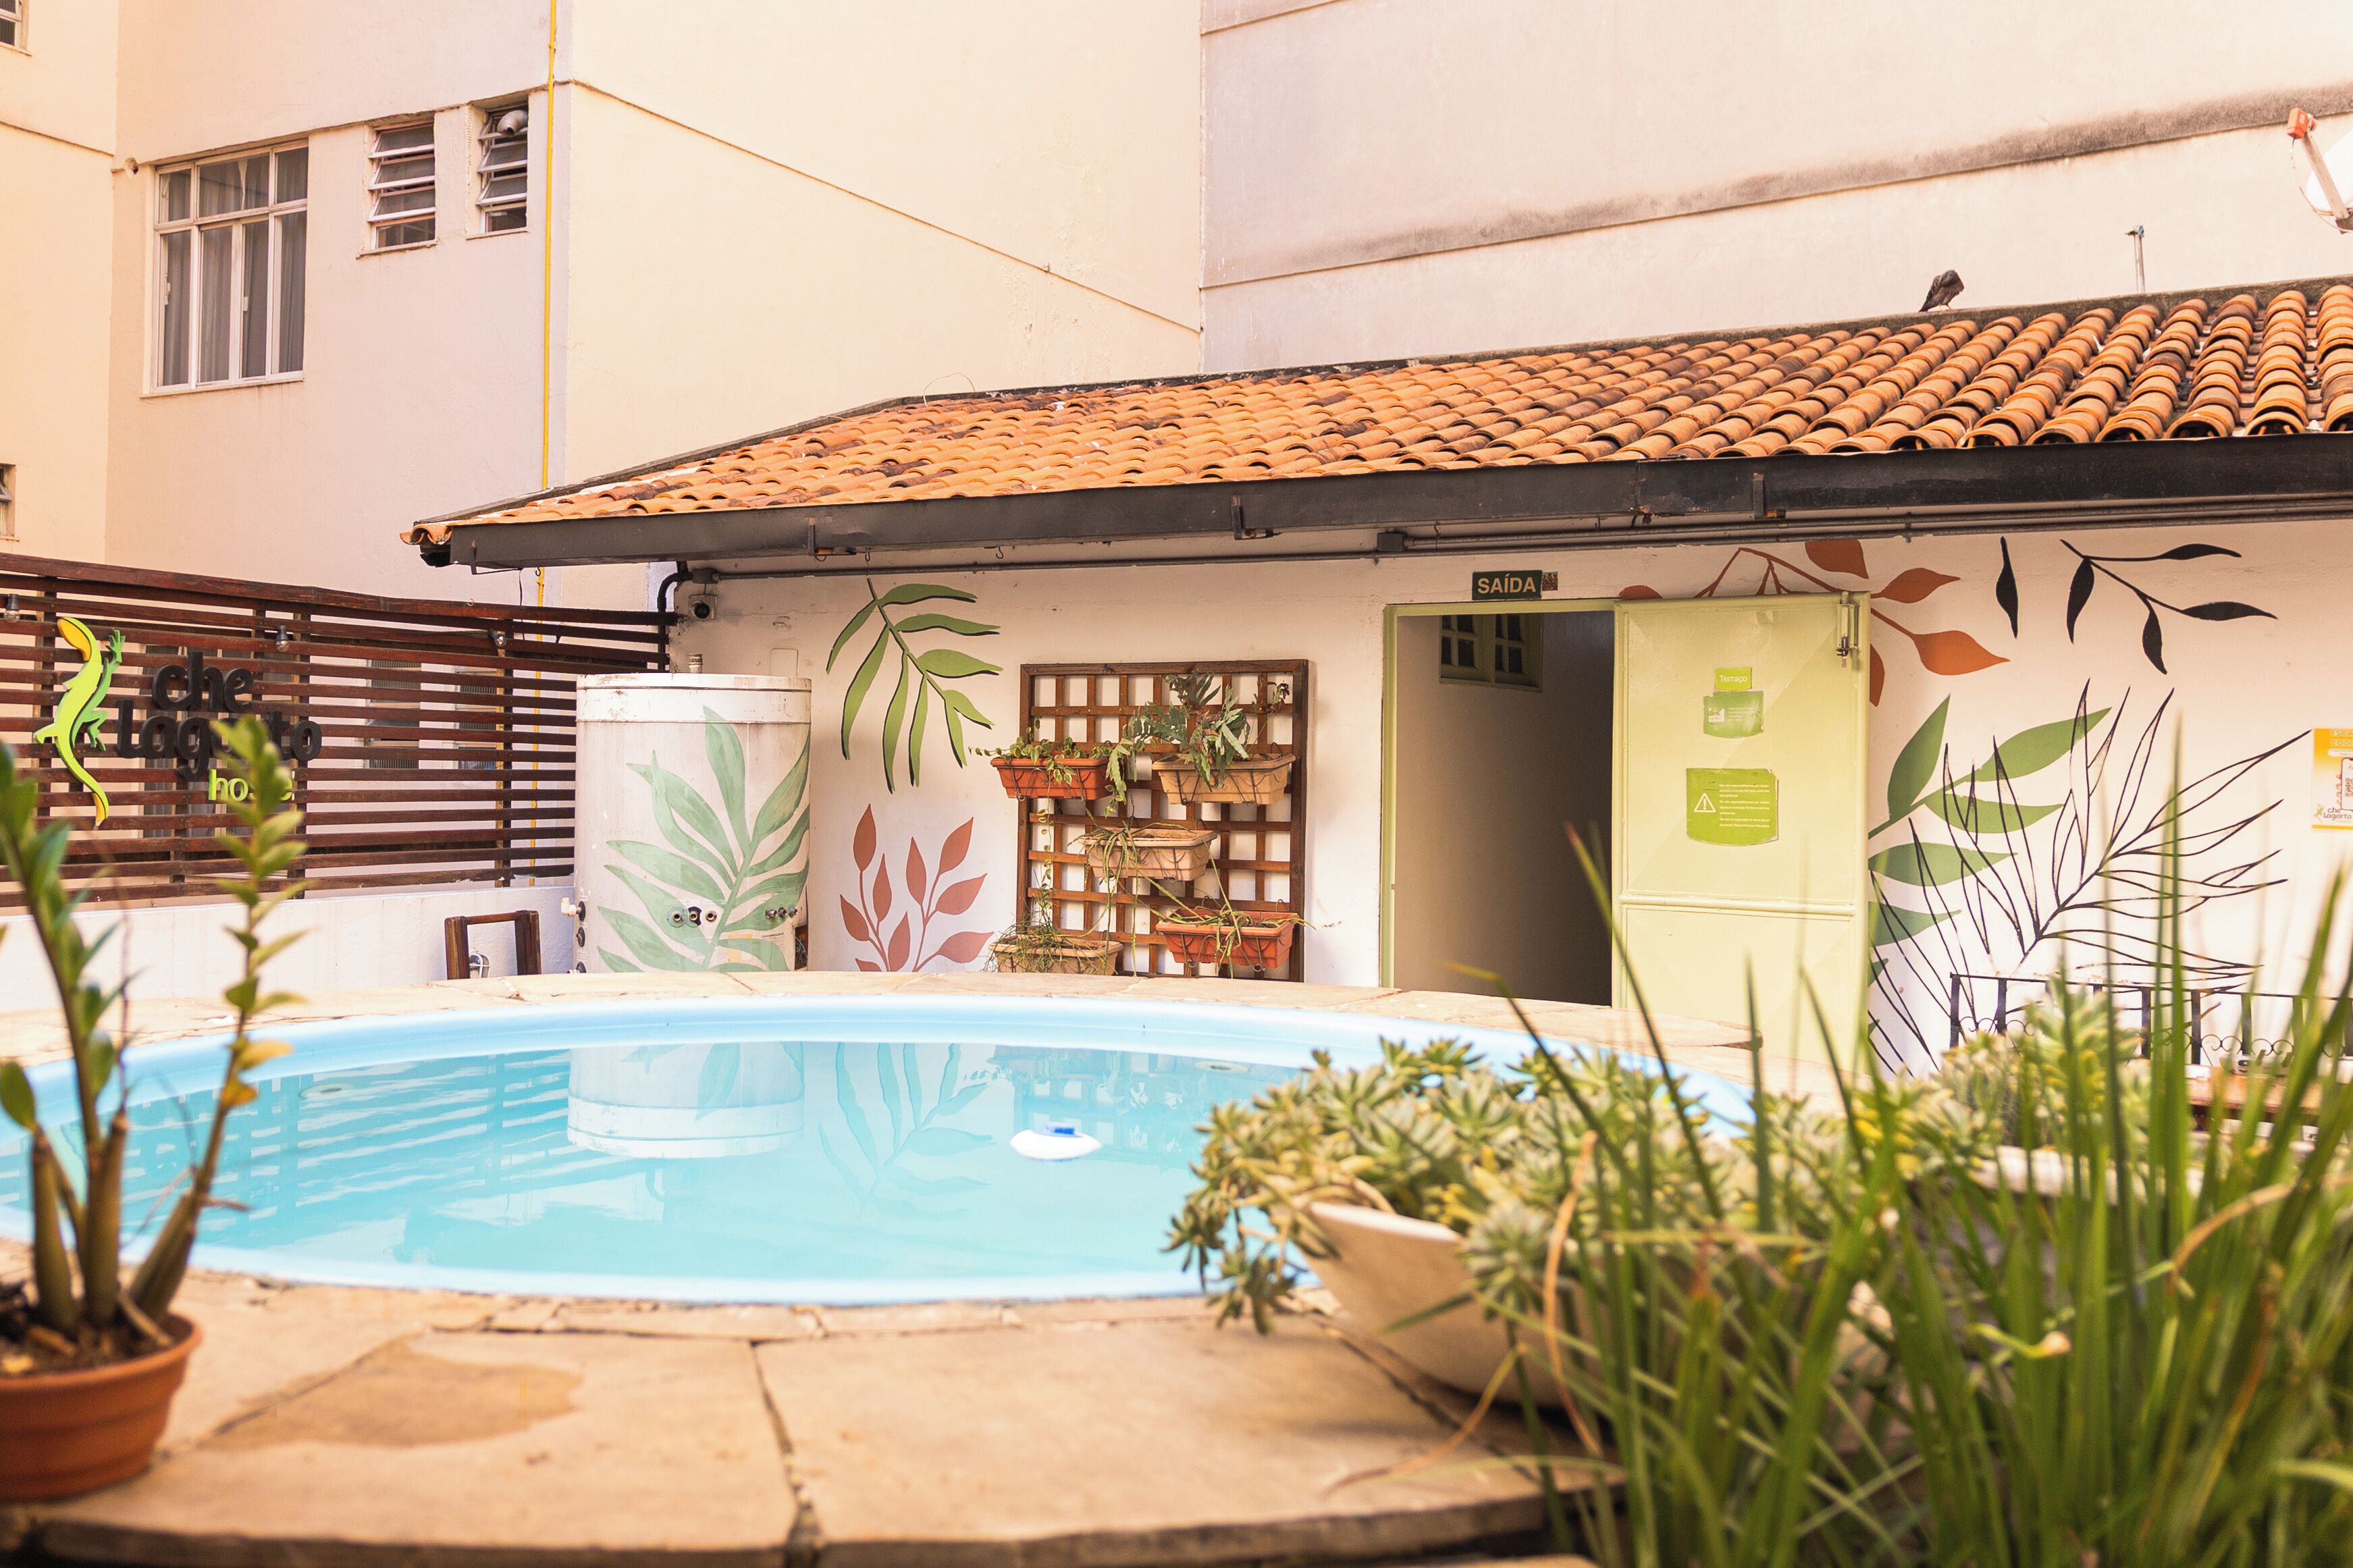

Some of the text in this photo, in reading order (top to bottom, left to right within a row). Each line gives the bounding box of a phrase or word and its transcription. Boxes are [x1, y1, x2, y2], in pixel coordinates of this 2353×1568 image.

[1477, 574, 1537, 594] SAÍDA
[151, 651, 254, 712] che
[1719, 674, 1748, 683] Terraço
[2323, 812, 2352, 821] Lagarto
